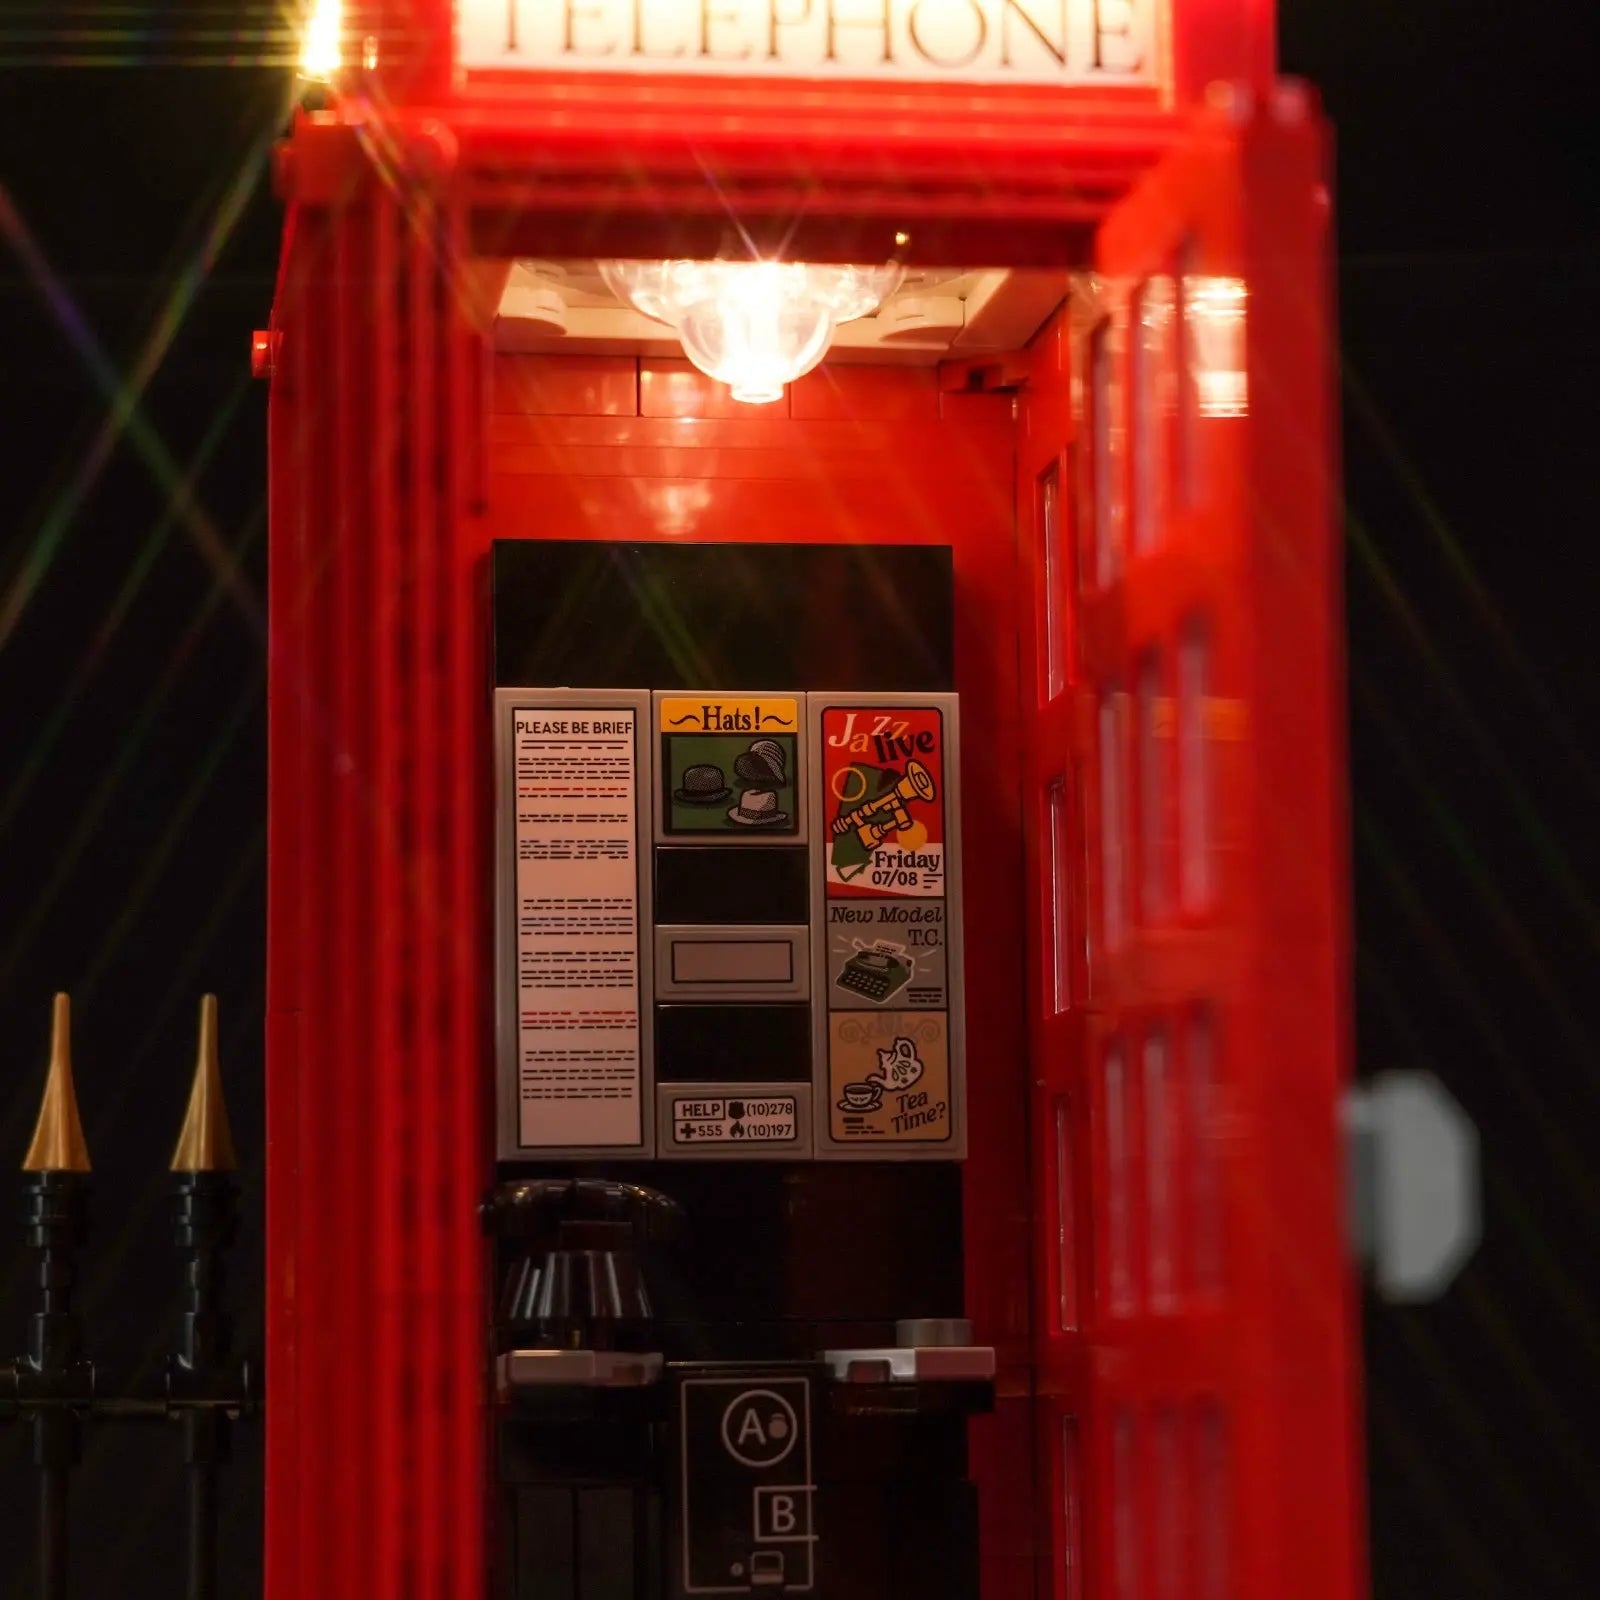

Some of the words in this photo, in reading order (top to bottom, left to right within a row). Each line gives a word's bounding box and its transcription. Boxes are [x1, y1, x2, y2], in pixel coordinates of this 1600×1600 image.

[702, 705, 761, 731] Hats!
[516, 721, 569, 735] PLEASE
[572, 721, 590, 735] BE
[594, 721, 633, 734] BRIEF
[873, 730, 935, 763] live
[874, 849, 941, 872] Friday
[871, 869, 918, 888] 07/08
[831, 906, 873, 923] New
[877, 906, 942, 923] Model
[907, 928, 943, 946] T.C.
[682, 1103, 720, 1117] HELP
[746, 1103, 793, 1117] (10)278
[896, 1091, 928, 1113] Tea
[890, 1101, 946, 1134] Time?
[698, 1125, 723, 1137] 555
[747, 1124, 792, 1138] (10)197
[738, 1408, 767, 1445] A
[772, 1495, 796, 1532] B
